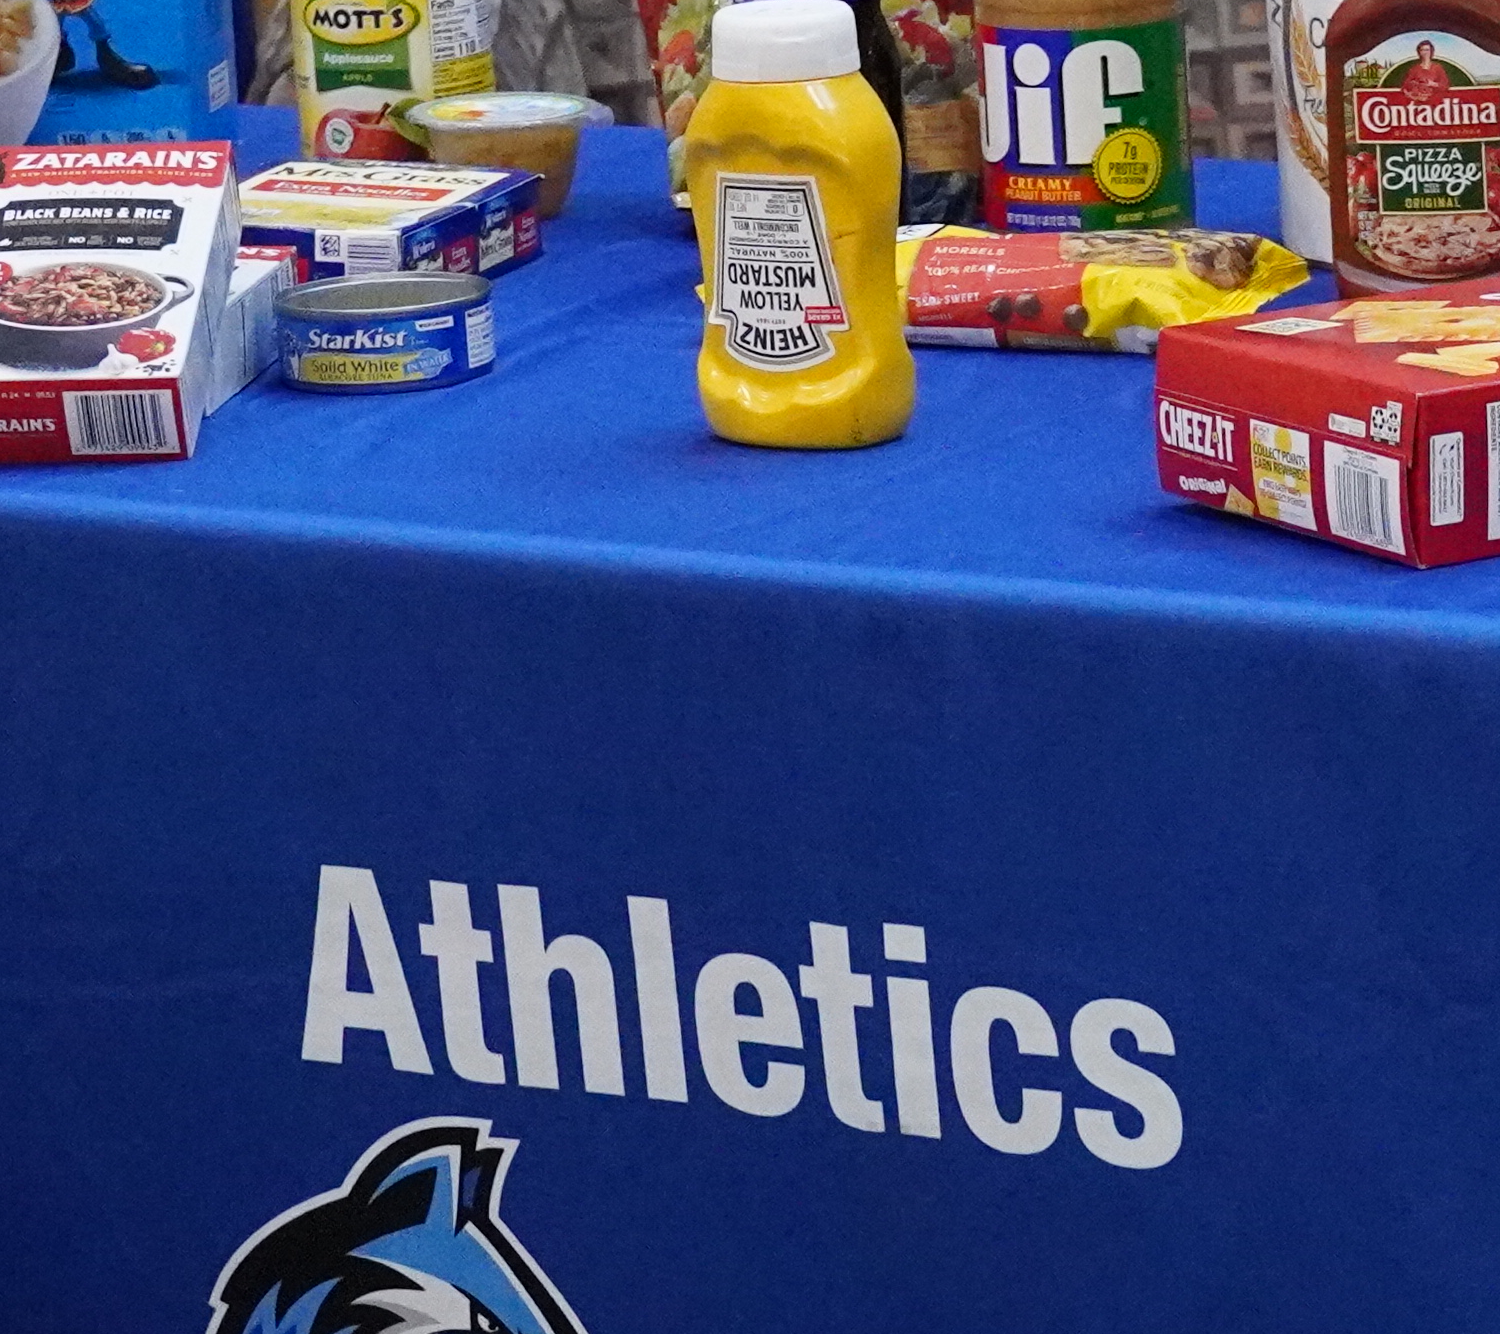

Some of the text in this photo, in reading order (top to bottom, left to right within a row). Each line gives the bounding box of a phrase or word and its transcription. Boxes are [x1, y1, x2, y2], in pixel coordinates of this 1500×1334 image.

[323, 52, 395, 66] Applesauce
[979, 41, 1145, 166] Jif
[1361, 98, 1497, 127] Contadina
[1122, 142, 1137, 160] 7g
[1405, 147, 1463, 163] PIZZA
[12, 150, 218, 171] ZATARAIN'S
[1108, 162, 1149, 175] PROTEIN
[1008, 176, 1073, 190] CREAMY
[1382, 159, 1480, 196] Squeeze
[340, 185, 430, 199] Noodles
[1042, 190, 1082, 201] BUTTER
[1405, 196, 1462, 209] ORIGINAL
[4, 207, 173, 221] BLACK BEANS & RICE
[729, 247, 776, 258] NATURAL
[934, 246, 1006, 256] MORSELS
[728, 262, 816, 288] MUSTARD
[740, 290, 803, 311] YELLOW
[308, 327, 408, 350] StarKist
[740, 322, 808, 351] HEINZ
[311, 359, 399, 374] Solid White
[302, 863, 1185, 1169] Athletics
